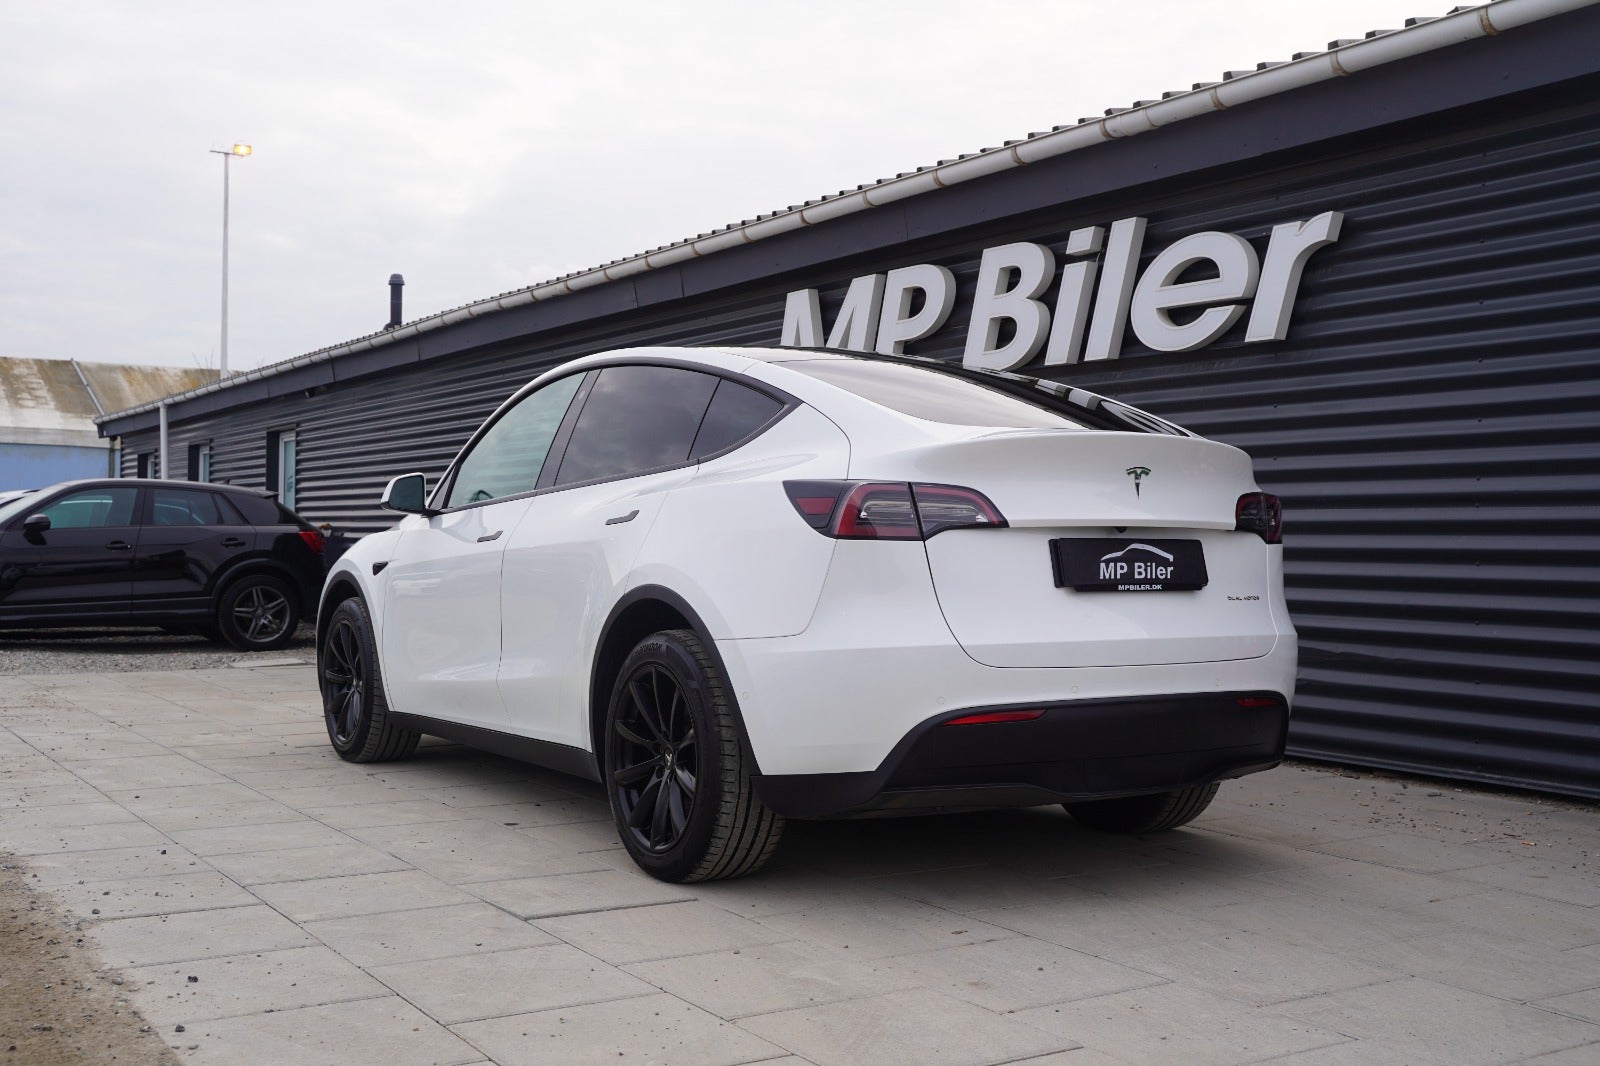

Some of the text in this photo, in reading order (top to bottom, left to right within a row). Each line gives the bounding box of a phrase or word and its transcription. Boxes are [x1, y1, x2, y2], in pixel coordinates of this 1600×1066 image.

[780, 210, 1345, 372] MP Biler
[1100, 562, 1173, 579] MP Biler
